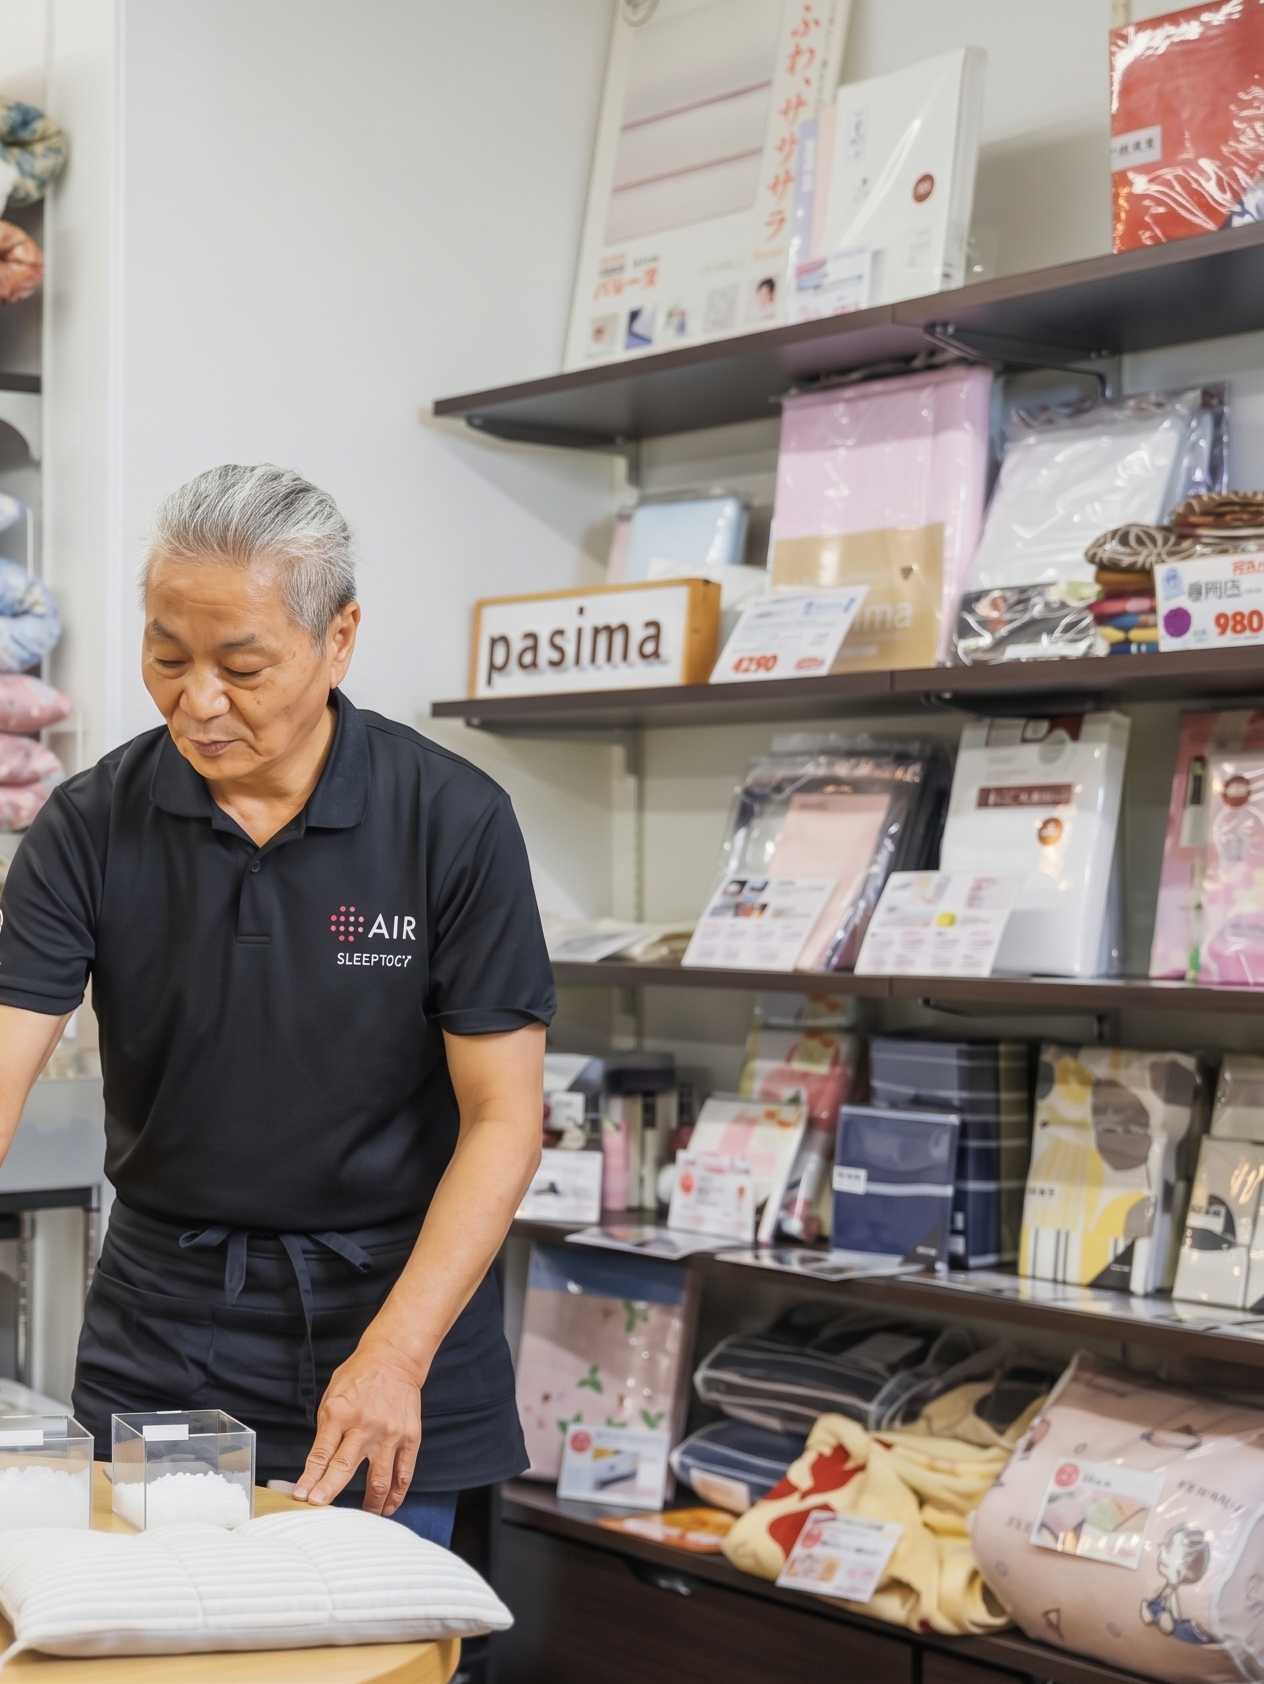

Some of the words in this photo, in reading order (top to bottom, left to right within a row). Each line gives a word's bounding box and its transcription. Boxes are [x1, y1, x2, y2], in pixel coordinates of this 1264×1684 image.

[1214, 609, 1264, 637] 980
[486, 606, 662, 687] pasima
[367, 912, 417, 941] AIR
